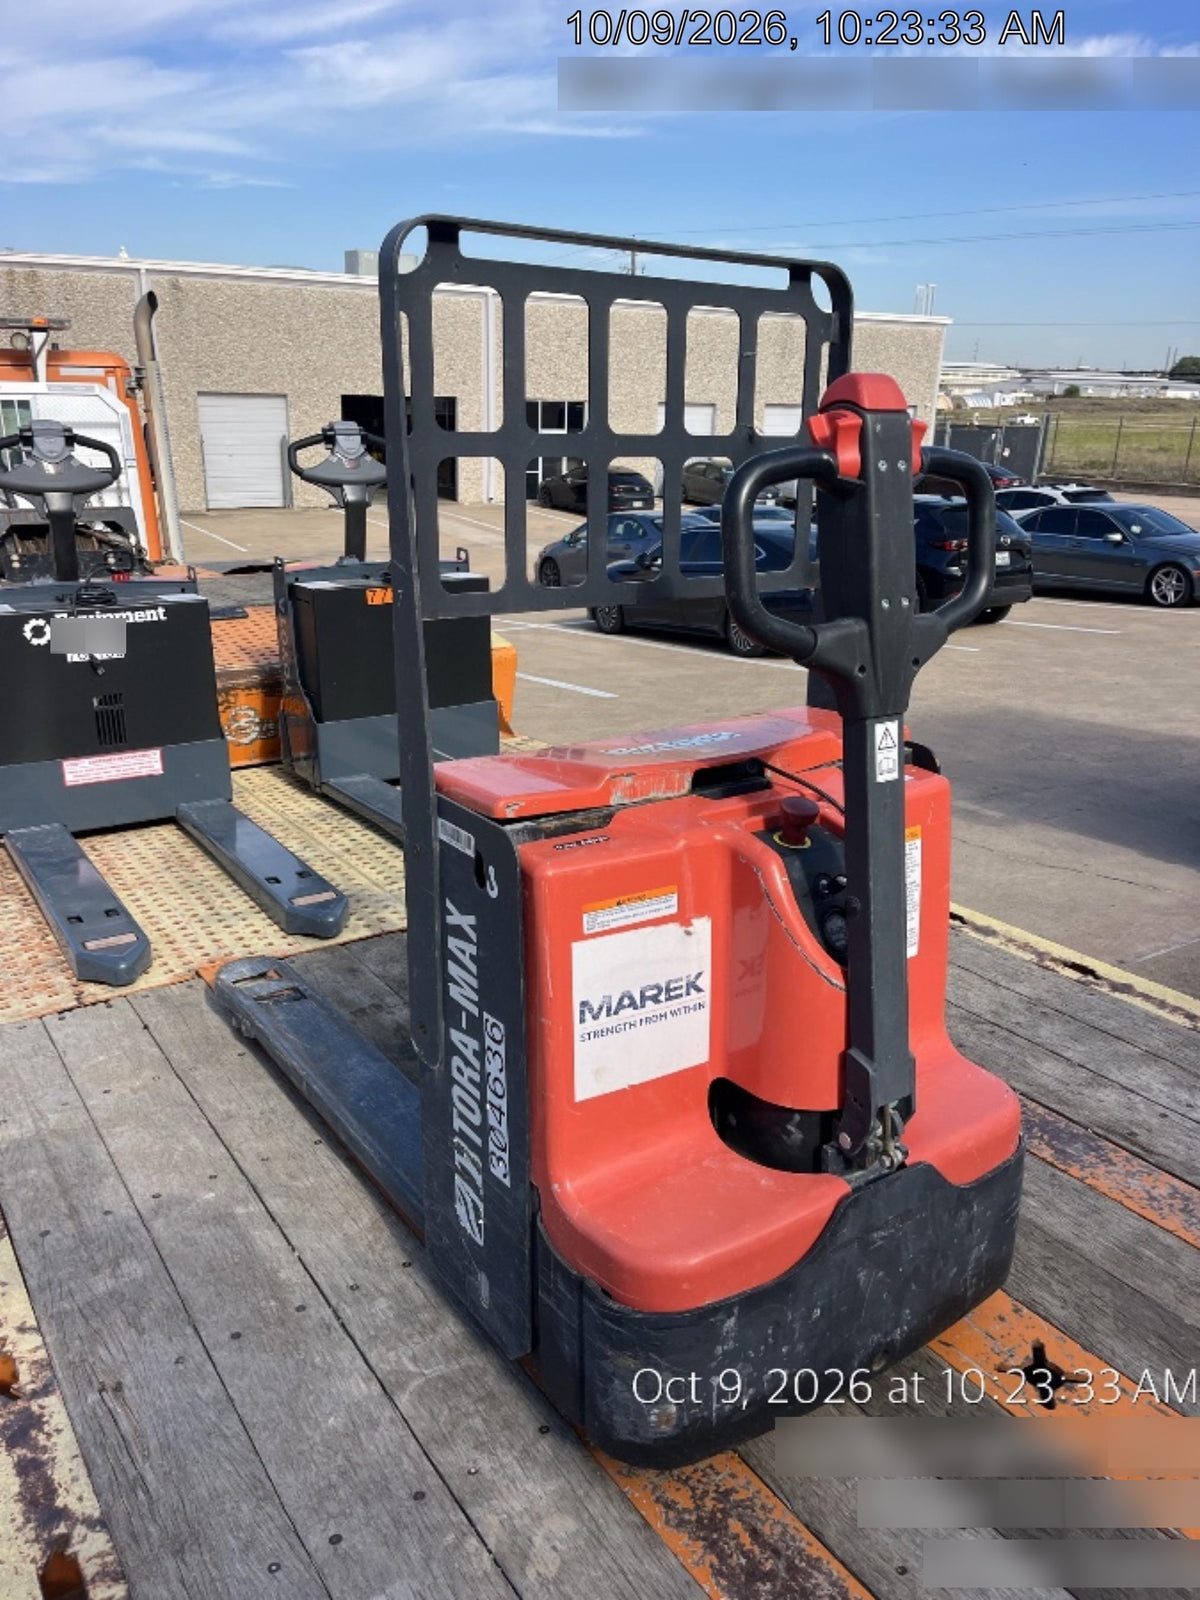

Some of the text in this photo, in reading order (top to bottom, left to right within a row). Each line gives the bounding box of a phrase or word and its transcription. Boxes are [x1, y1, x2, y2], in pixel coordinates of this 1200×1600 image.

[579, 971, 705, 1024] MAREK
[579, 1002, 705, 1043] STRENGTH FROM WITHIN
[485, 1018, 508, 1179] 304636
